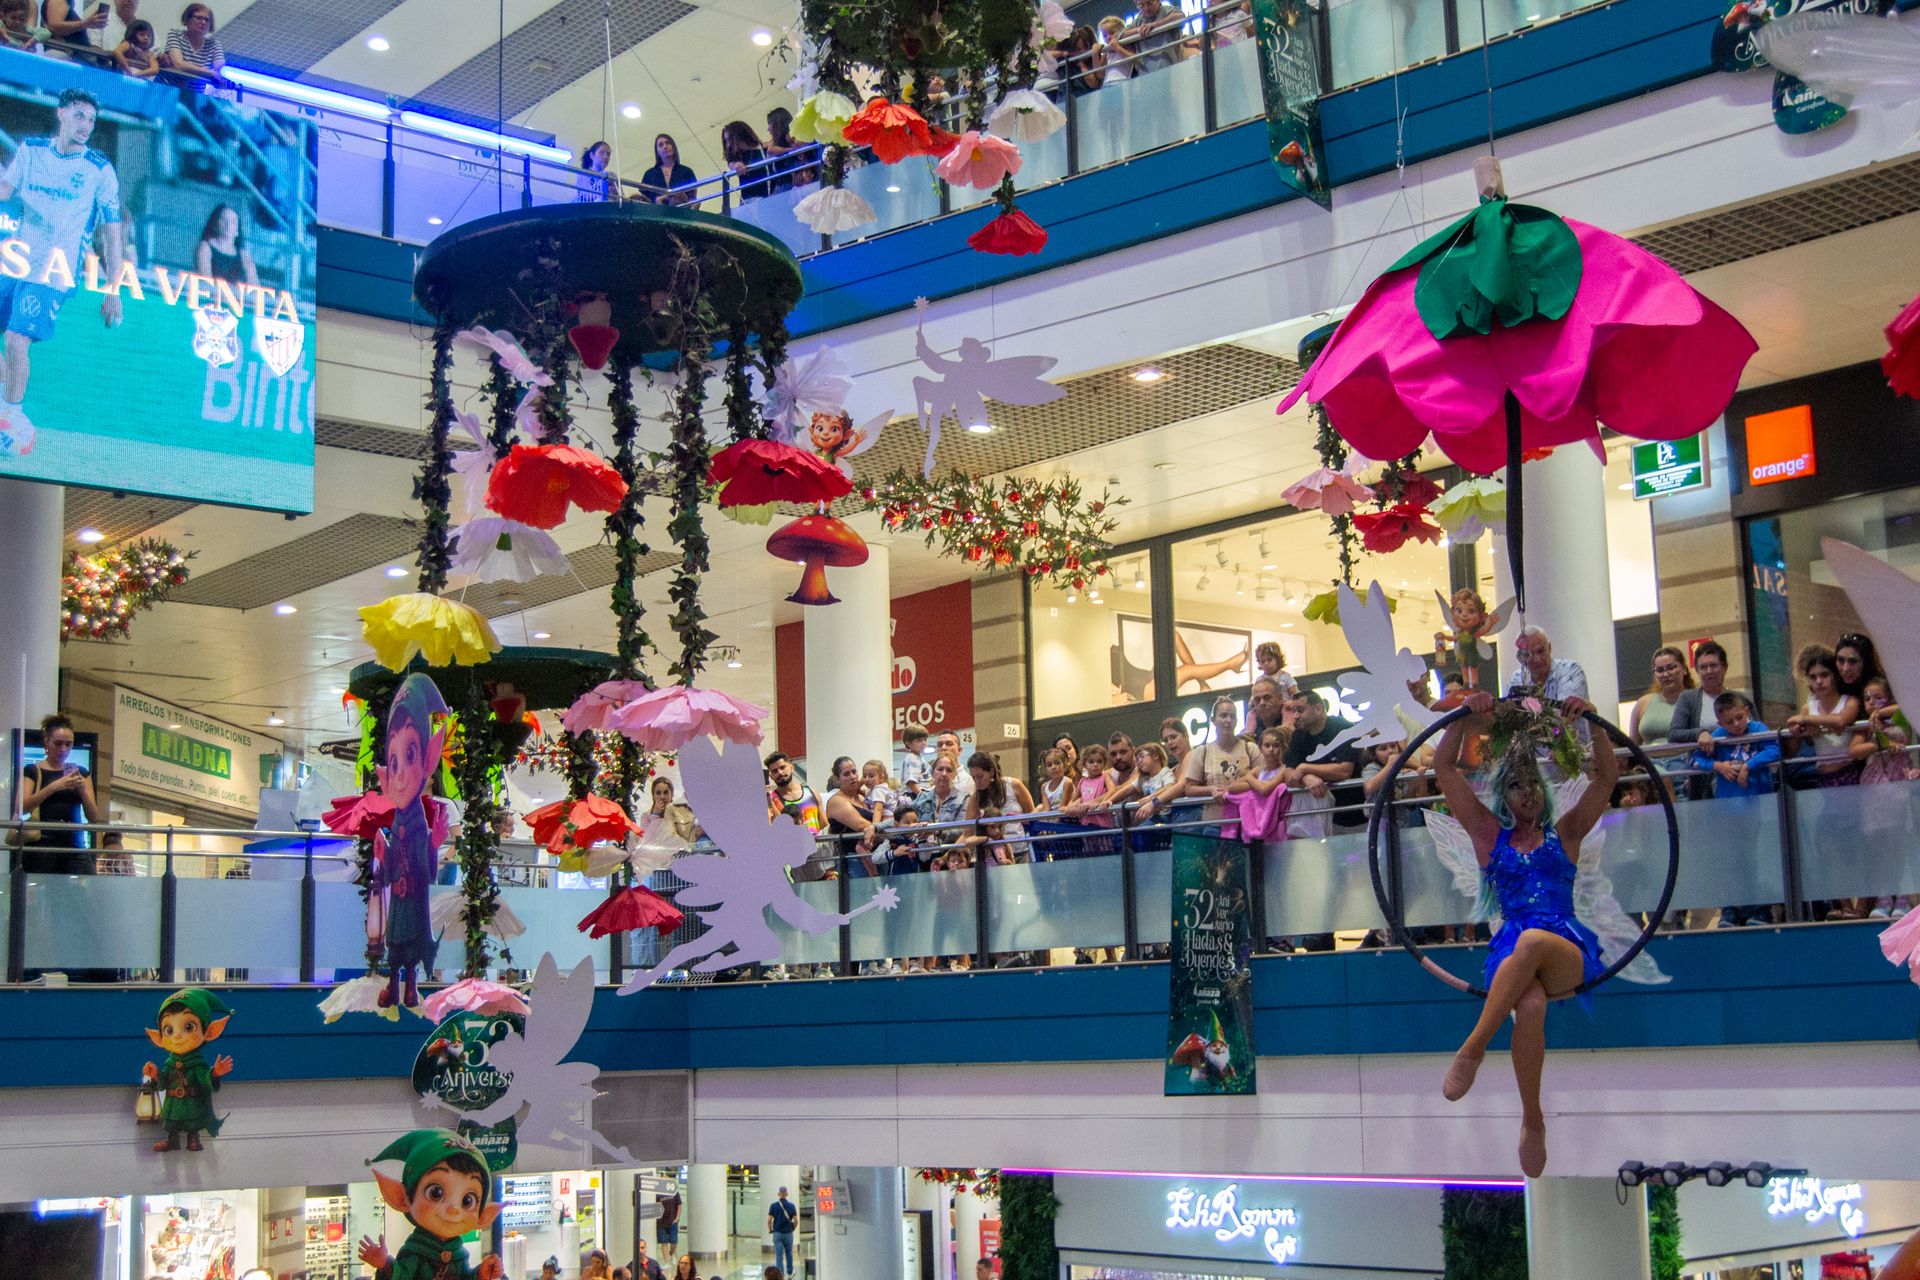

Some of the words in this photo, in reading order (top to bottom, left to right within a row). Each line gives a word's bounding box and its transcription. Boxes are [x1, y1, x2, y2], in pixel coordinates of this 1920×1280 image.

[1263, 17, 1293, 61] 32
[41, 247, 76, 288] A
[84, 254, 145, 301] LA
[155, 266, 301, 323] VENTA
[119, 693, 166, 719] ARREGLOS
[166, 708, 174, 721] Y
[173, 712, 252, 747] TRANSFORMACIONES
[963, 733, 973, 743] 25
[1007, 725, 1017, 736] 26
[120, 760, 137, 775] Todo
[151, 768, 160, 782] de
[146, 729, 229, 775] ARIADNA
[1184, 889, 1214, 930] 32
